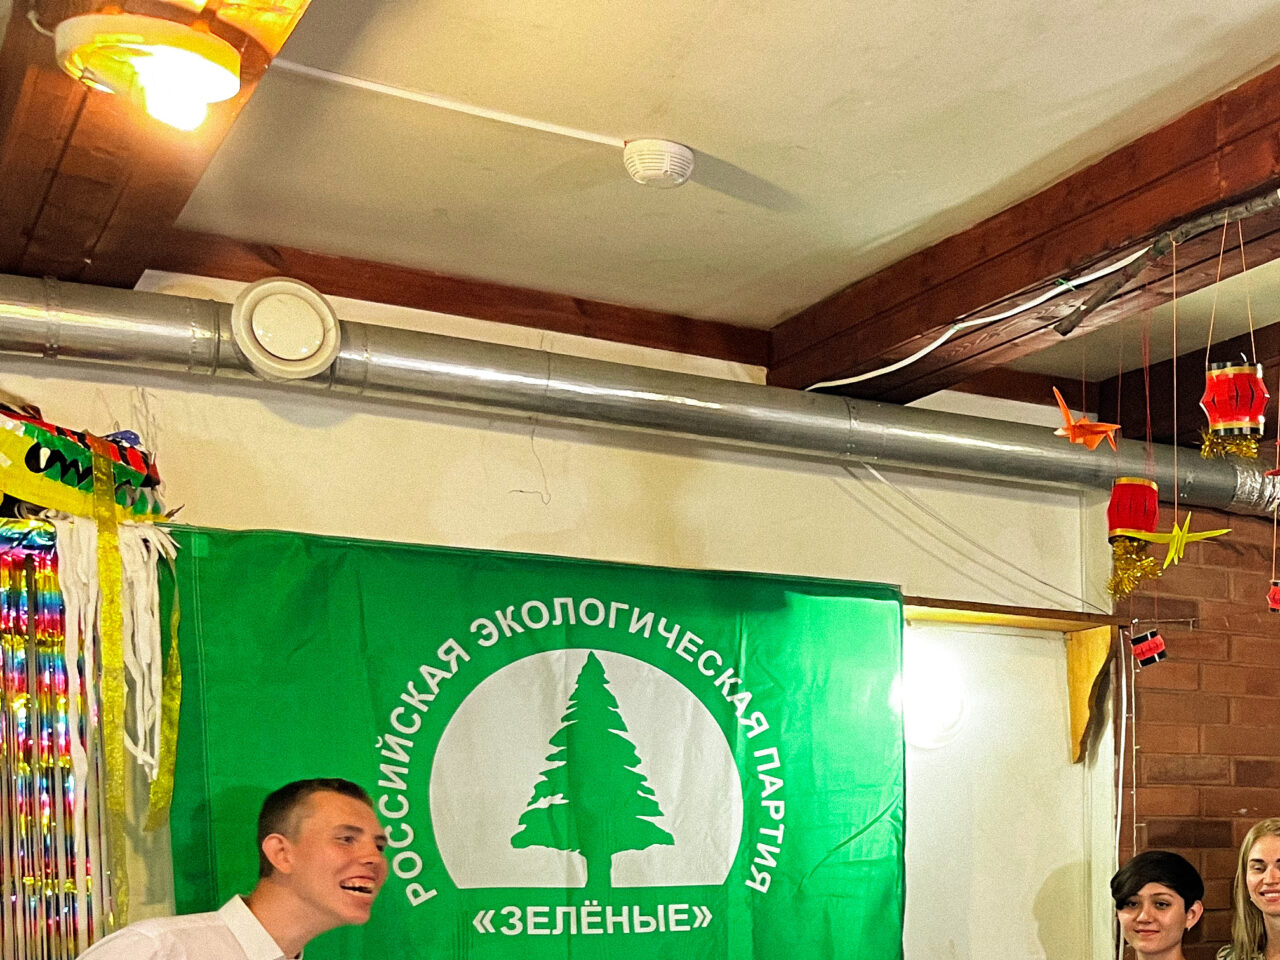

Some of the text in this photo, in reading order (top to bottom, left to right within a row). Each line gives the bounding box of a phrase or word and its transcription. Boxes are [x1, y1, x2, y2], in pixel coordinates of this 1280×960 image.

[375, 597, 786, 907] РОССИЙСКАЯ ЭКОЛОГИЧЕСКАЯ ПАРТИЯ
[472, 899, 713, 935] «ЗЕЛЁНЫЕ»
